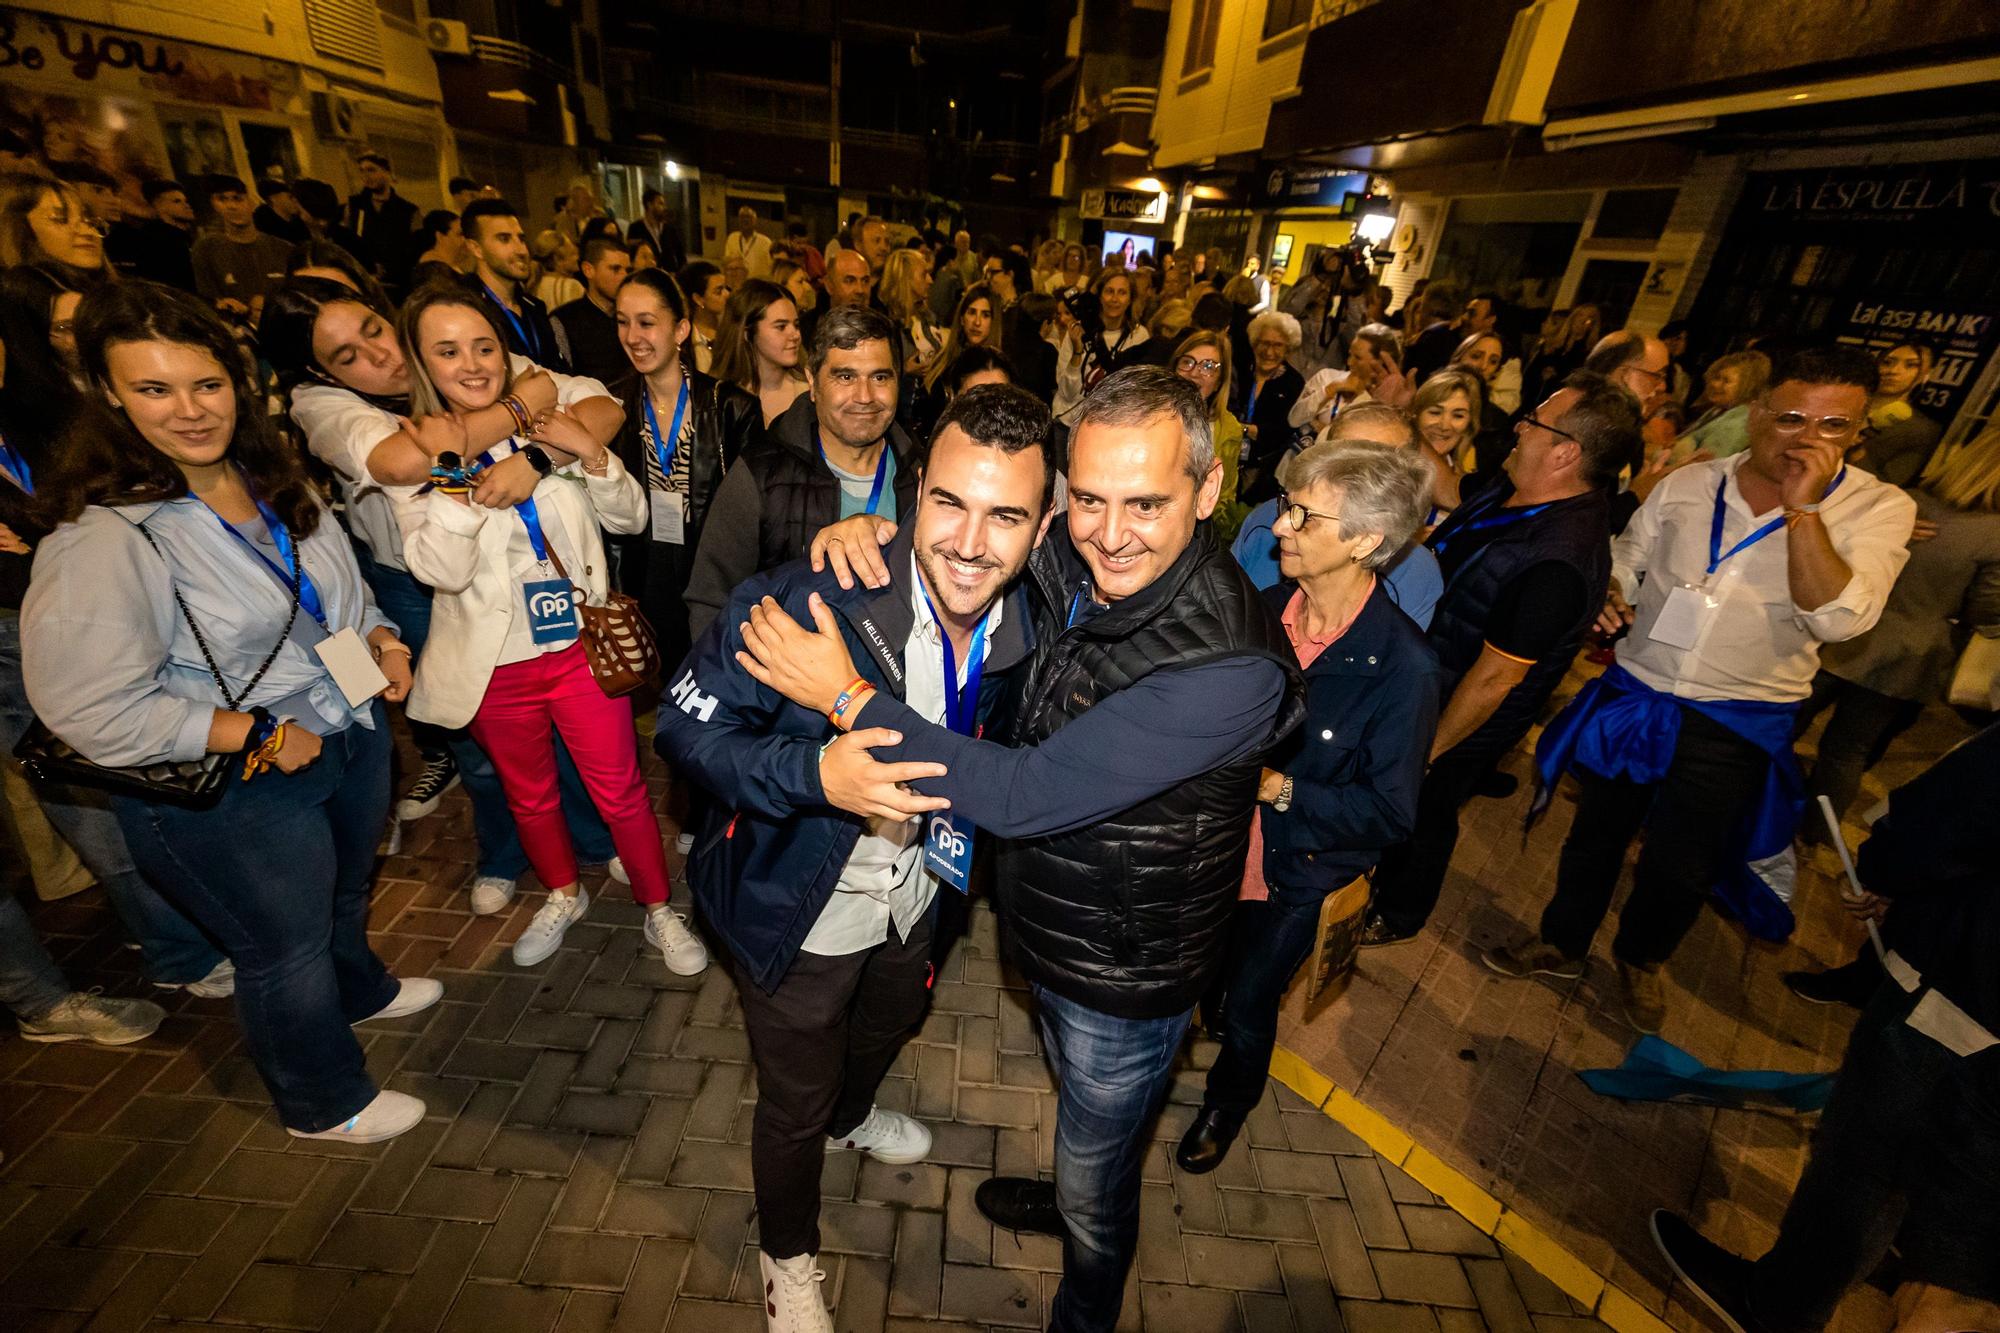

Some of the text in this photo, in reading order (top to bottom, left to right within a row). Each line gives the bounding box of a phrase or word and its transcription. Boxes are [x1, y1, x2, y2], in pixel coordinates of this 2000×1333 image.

[1762, 184, 1802, 212] LA
[862, 619, 903, 682] HELLY HANSEN
[928, 850, 965, 878] APODERADO
